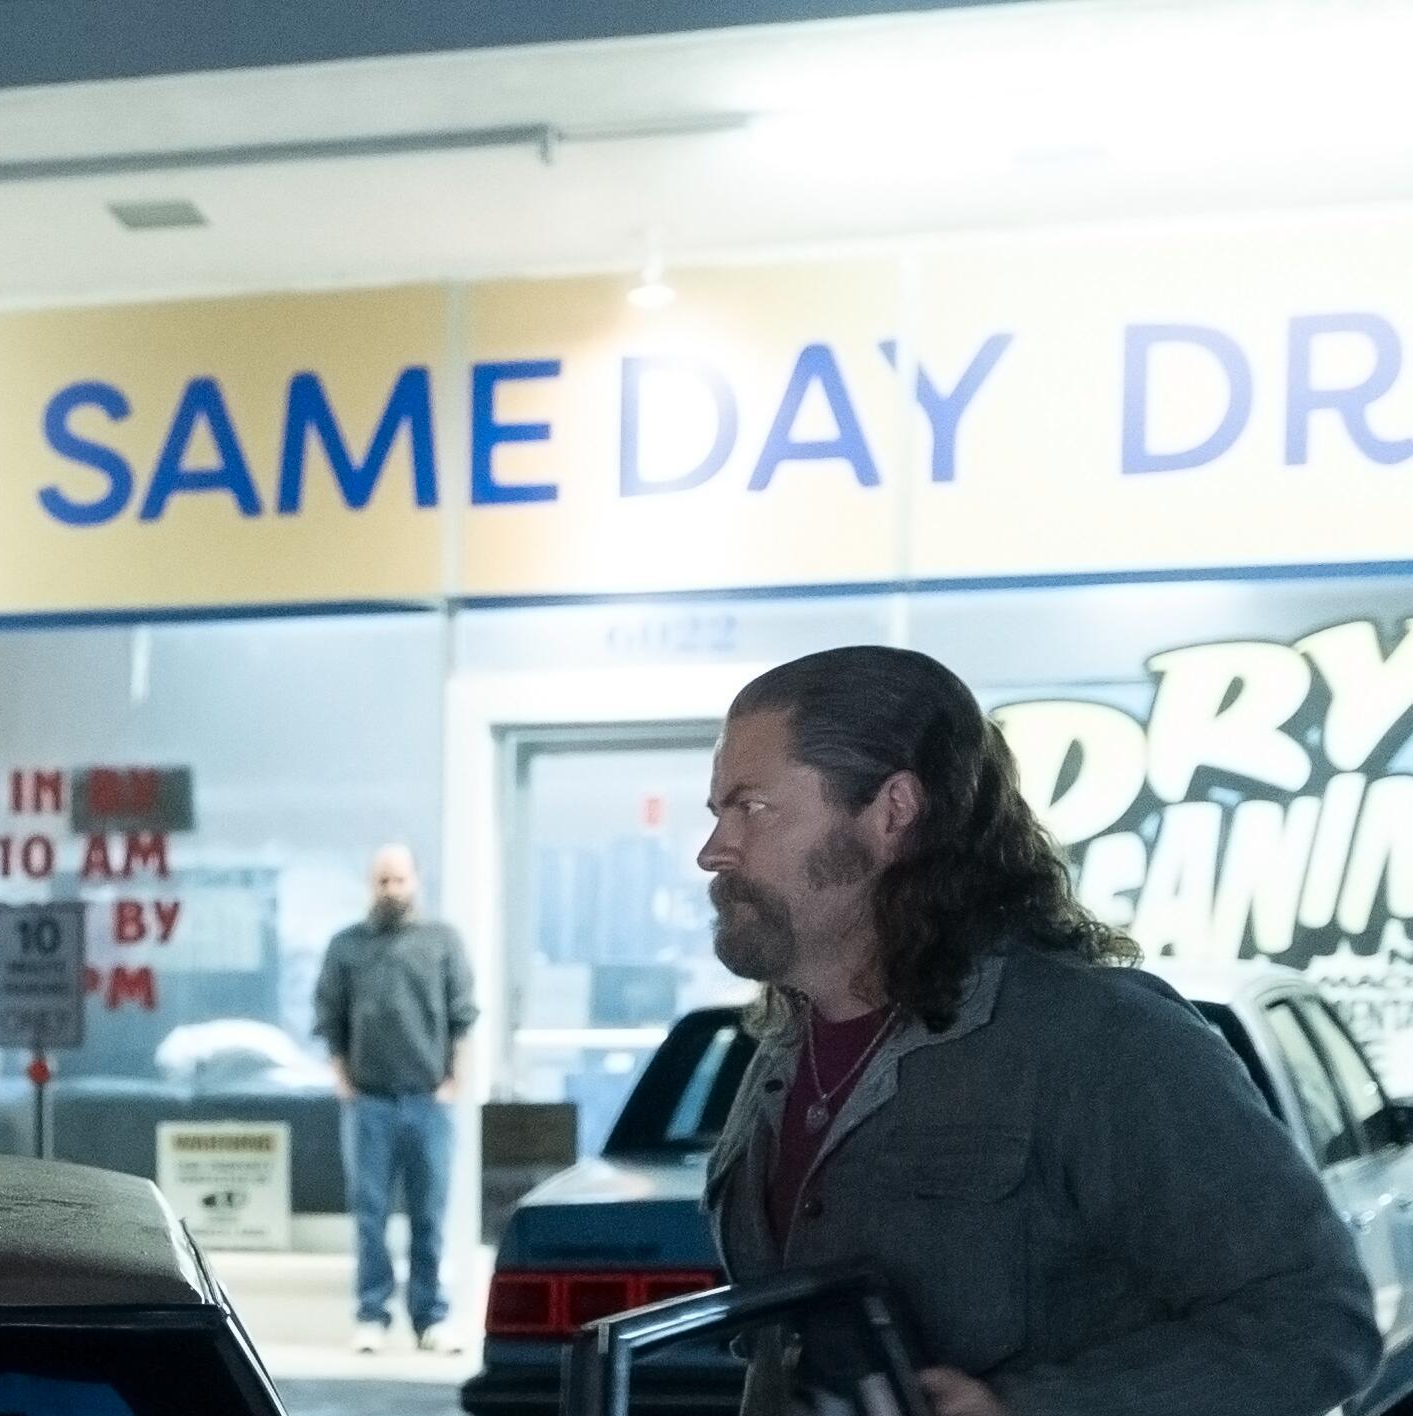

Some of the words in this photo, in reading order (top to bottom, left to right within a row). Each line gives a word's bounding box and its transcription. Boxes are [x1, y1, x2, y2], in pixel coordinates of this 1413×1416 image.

[36, 357, 564, 528] SAME
[618, 331, 1016, 499] DAY
[1118, 311, 1413, 476] DR
[990, 617, 1413, 848] DRY
[10, 768, 63, 814] IN
[81, 833, 171, 881] AM
[16, 917, 63, 956] 10
[112, 899, 182, 945] BY
